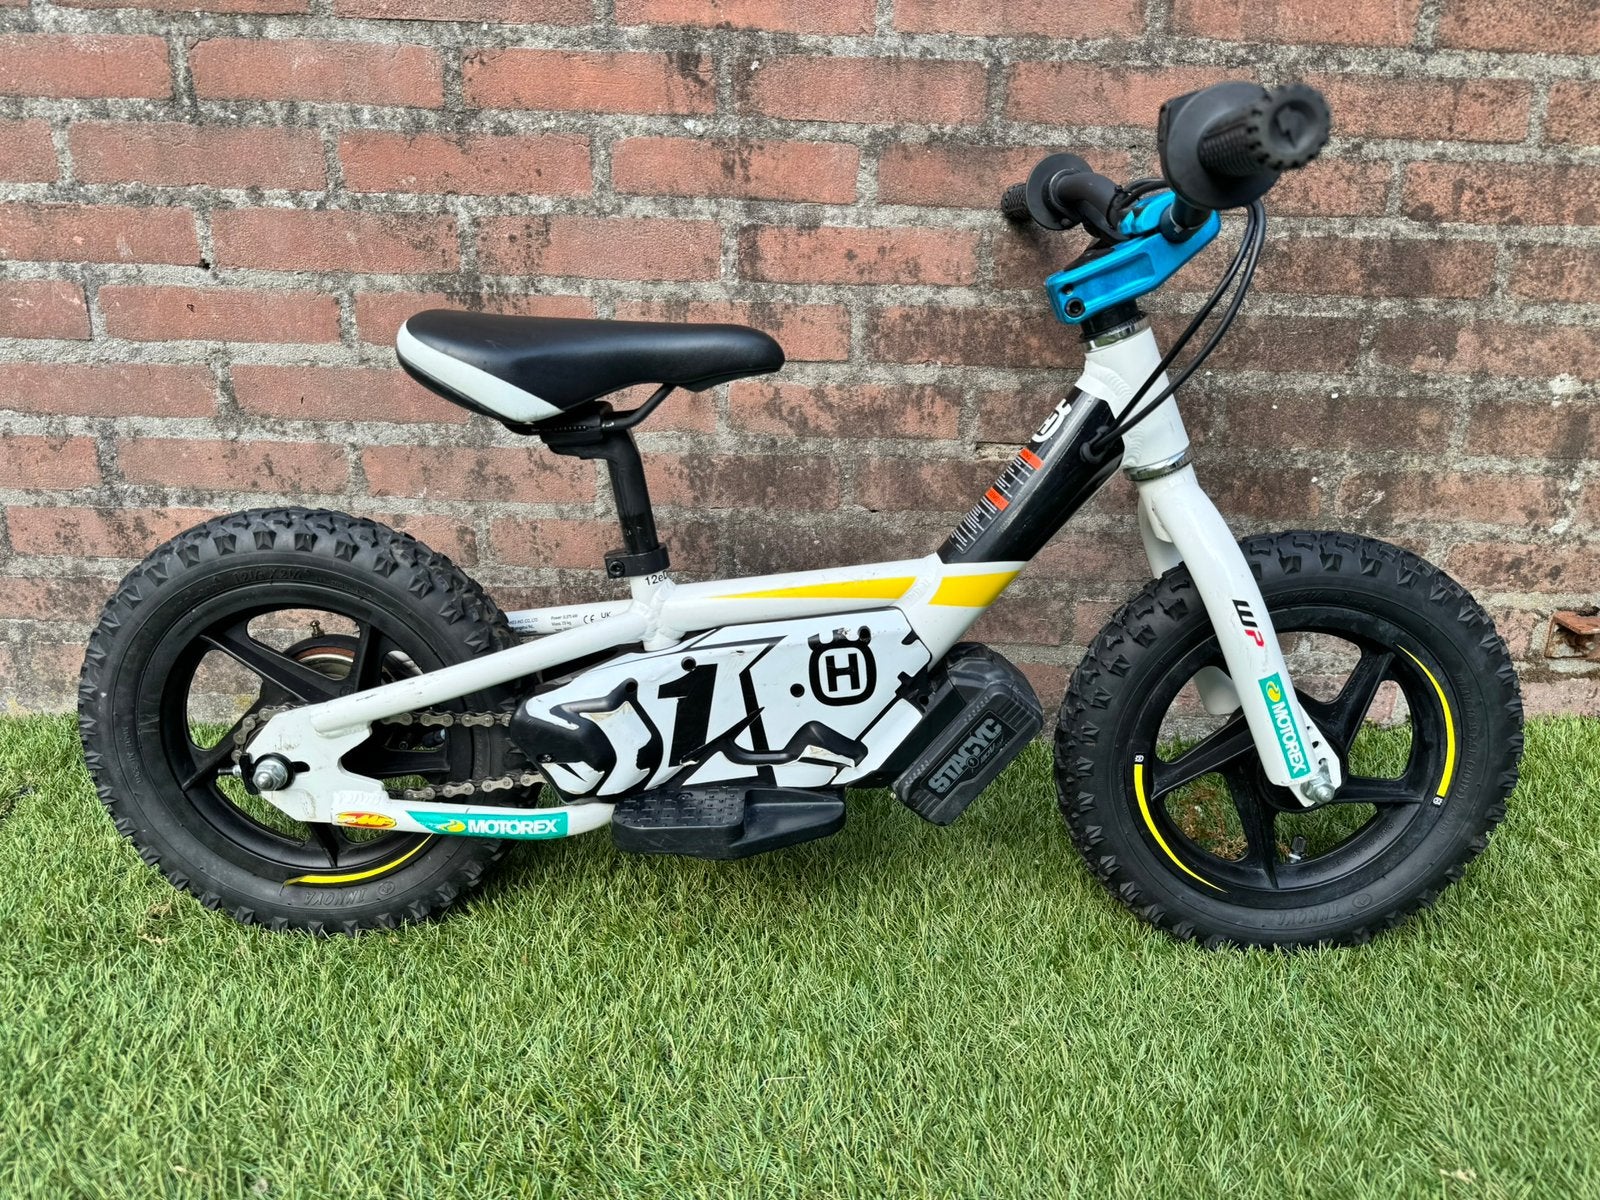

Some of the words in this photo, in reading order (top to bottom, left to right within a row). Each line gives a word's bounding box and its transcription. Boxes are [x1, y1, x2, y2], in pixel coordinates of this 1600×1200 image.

[1232, 599, 1265, 647] WP
[928, 718, 1002, 793] STACYC
[1272, 702, 1306, 774] MOTOREX
[467, 820, 560, 834] MOTOREX
